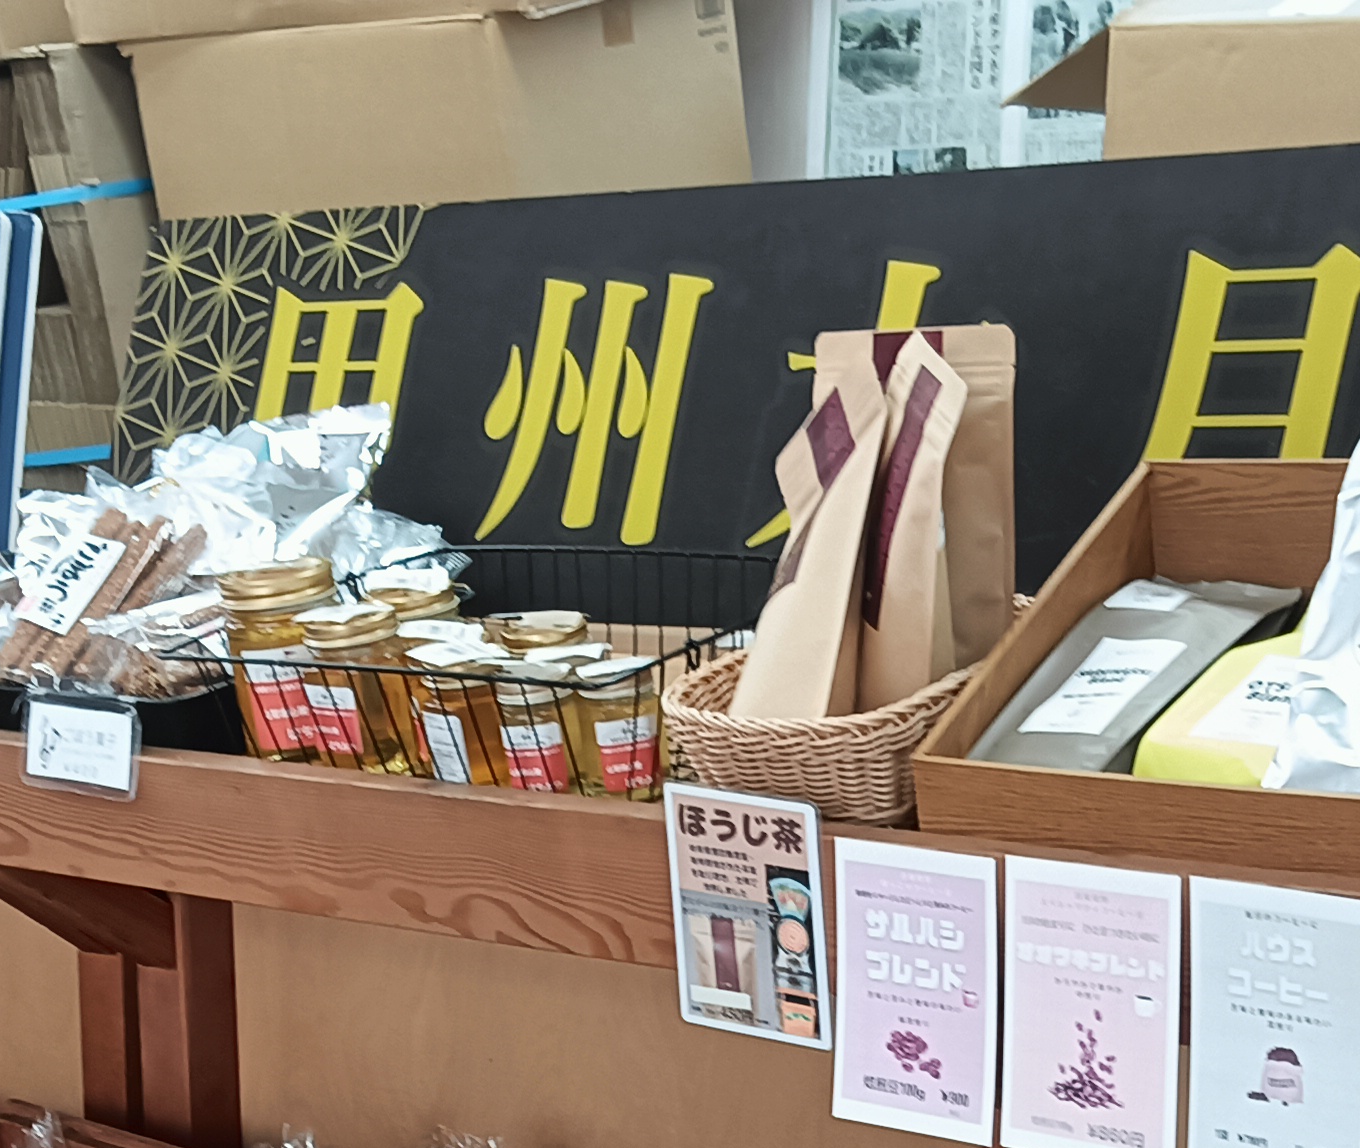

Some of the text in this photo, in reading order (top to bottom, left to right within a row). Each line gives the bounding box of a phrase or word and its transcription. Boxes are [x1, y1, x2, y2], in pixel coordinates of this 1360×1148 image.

[679, 803, 802, 853] ほうじ茶
[865, 909, 965, 950] サルハシ
[1240, 932, 1318, 967] ハウス
[865, 951, 967, 992] ブレンド
[1226, 967, 1330, 1006] コーヒー
